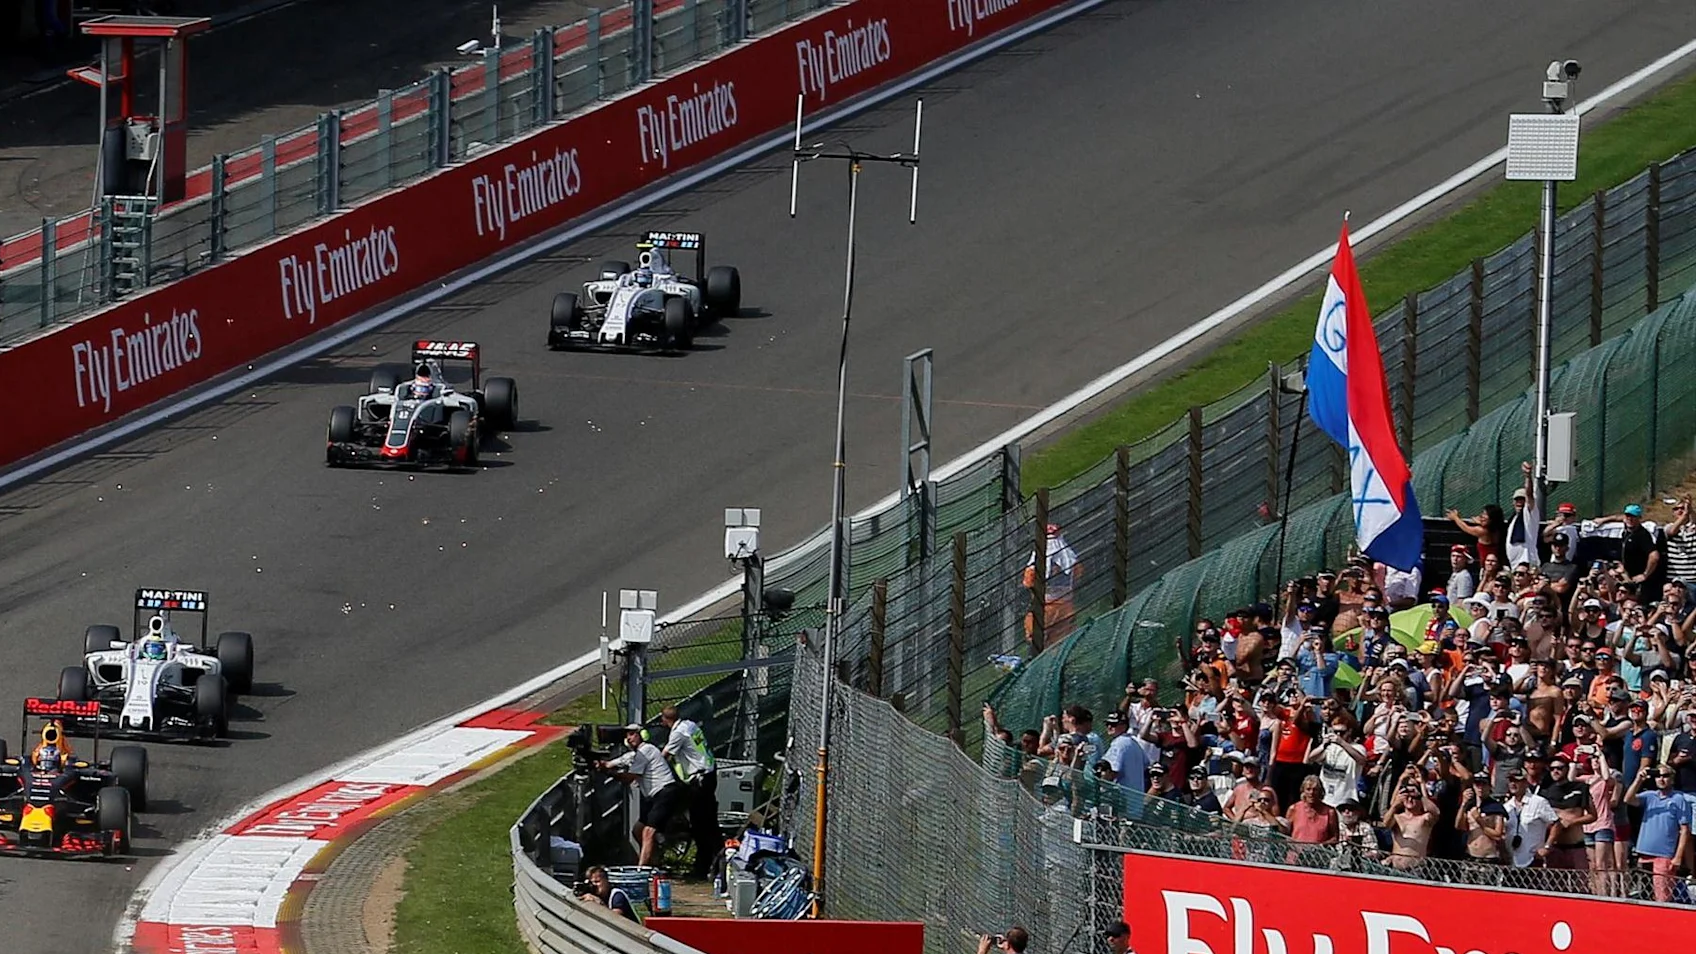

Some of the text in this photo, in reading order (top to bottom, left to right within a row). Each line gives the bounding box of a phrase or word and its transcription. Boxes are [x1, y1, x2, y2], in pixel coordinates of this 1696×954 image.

[795, 18, 891, 101] Fly Emirates
[637, 78, 738, 168] Fly Emirates
[472, 147, 581, 241] Fly Emirates
[279, 223, 400, 325] Fly Emirates
[71, 308, 202, 413] Fly Emirates
[141, 589, 203, 601] MARTINI
